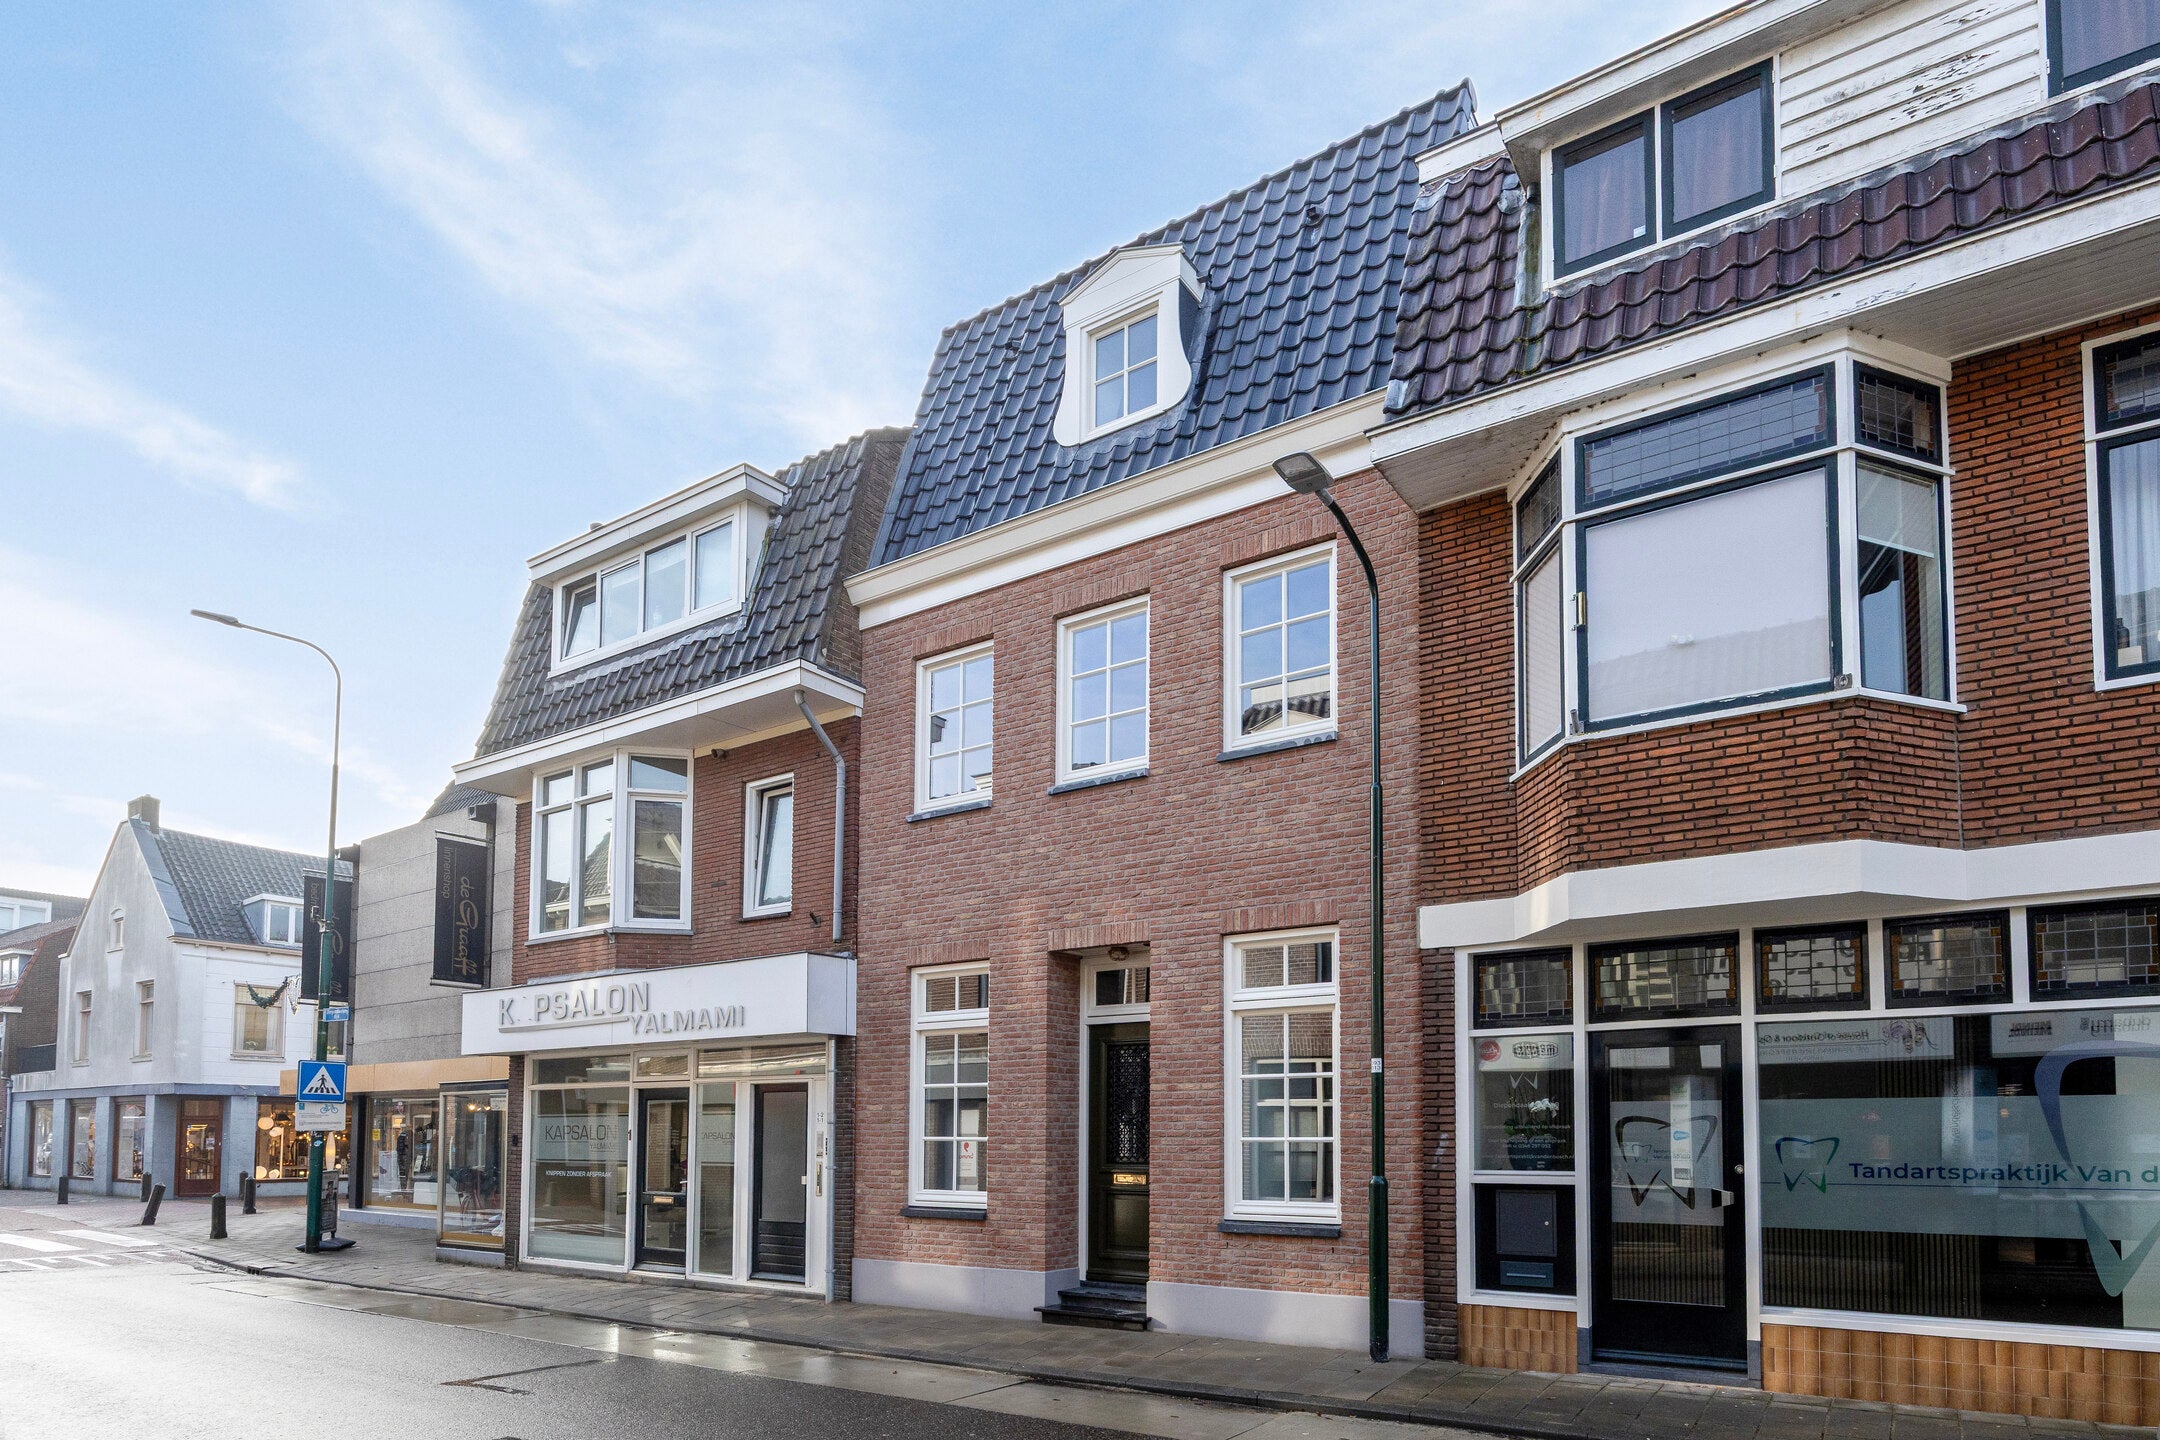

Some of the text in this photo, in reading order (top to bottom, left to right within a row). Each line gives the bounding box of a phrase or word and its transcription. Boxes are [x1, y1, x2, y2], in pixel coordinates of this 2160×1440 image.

[629, 1005, 746, 1034] YALMAMI
[545, 1124, 617, 1141] KAPSALON
[1849, 1162, 2068, 1186] Tandartspraktijk
[2077, 1165, 2131, 1183] Van
